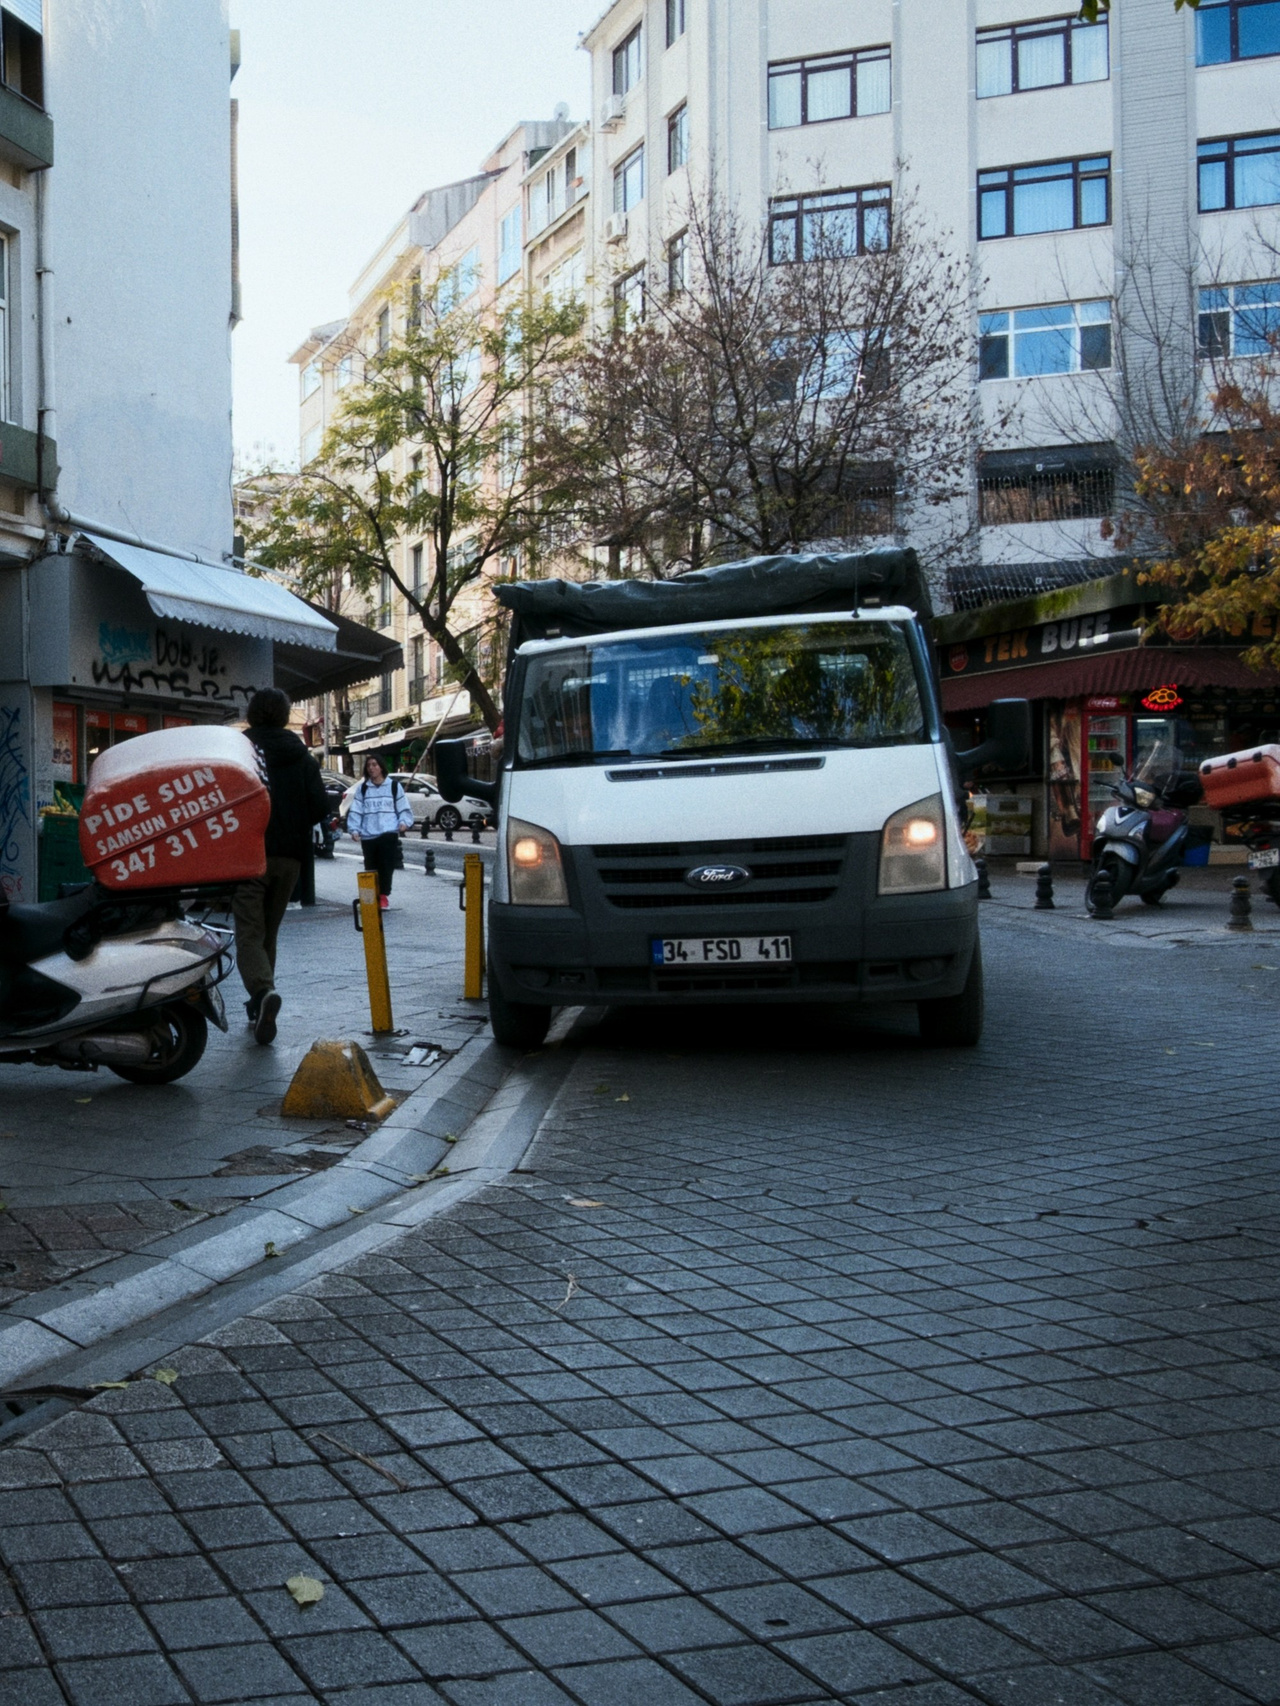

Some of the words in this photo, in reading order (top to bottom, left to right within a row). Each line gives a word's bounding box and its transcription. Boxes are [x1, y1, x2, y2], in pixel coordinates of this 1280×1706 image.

[984, 629, 1029, 664] TEK
[158, 767, 216, 804] SUN
[96, 814, 167, 856] SAMSUN
[111, 845, 156, 881] 347
[166, 828, 198, 857] 31
[206, 809, 240, 840] 55
[701, 868, 734, 882] Ford
[664, 941, 688, 962] 34
[703, 940, 741, 961] FSD
[758, 938, 791, 959] 411
